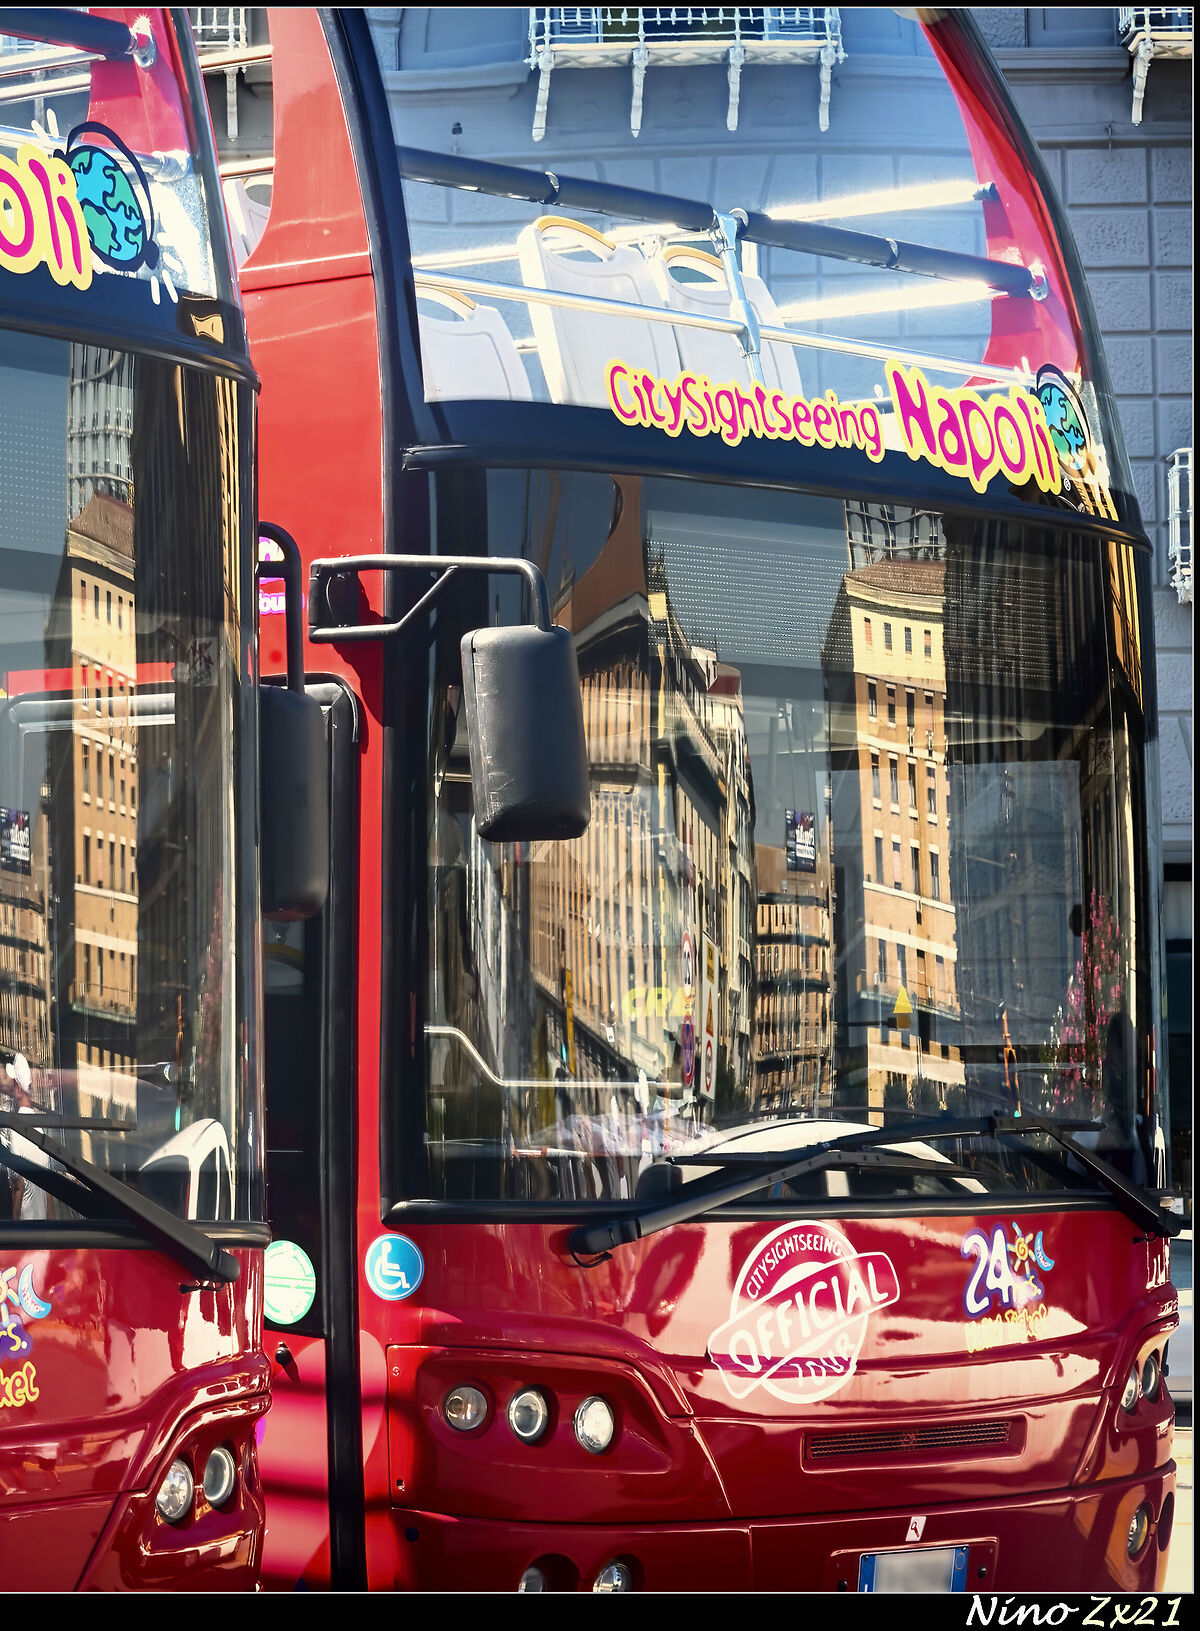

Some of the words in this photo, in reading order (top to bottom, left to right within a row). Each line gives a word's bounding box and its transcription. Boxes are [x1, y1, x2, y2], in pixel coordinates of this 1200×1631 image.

[606, 361, 884, 461] CitySightseeing
[888, 363, 1061, 491] Napoli
[746, 1234, 841, 1299] CITYSIGHTSEEING
[963, 1229, 1014, 1314] 24
[729, 1262, 888, 1373] OFFICIAL
[789, 1332, 854, 1387] TOUR
